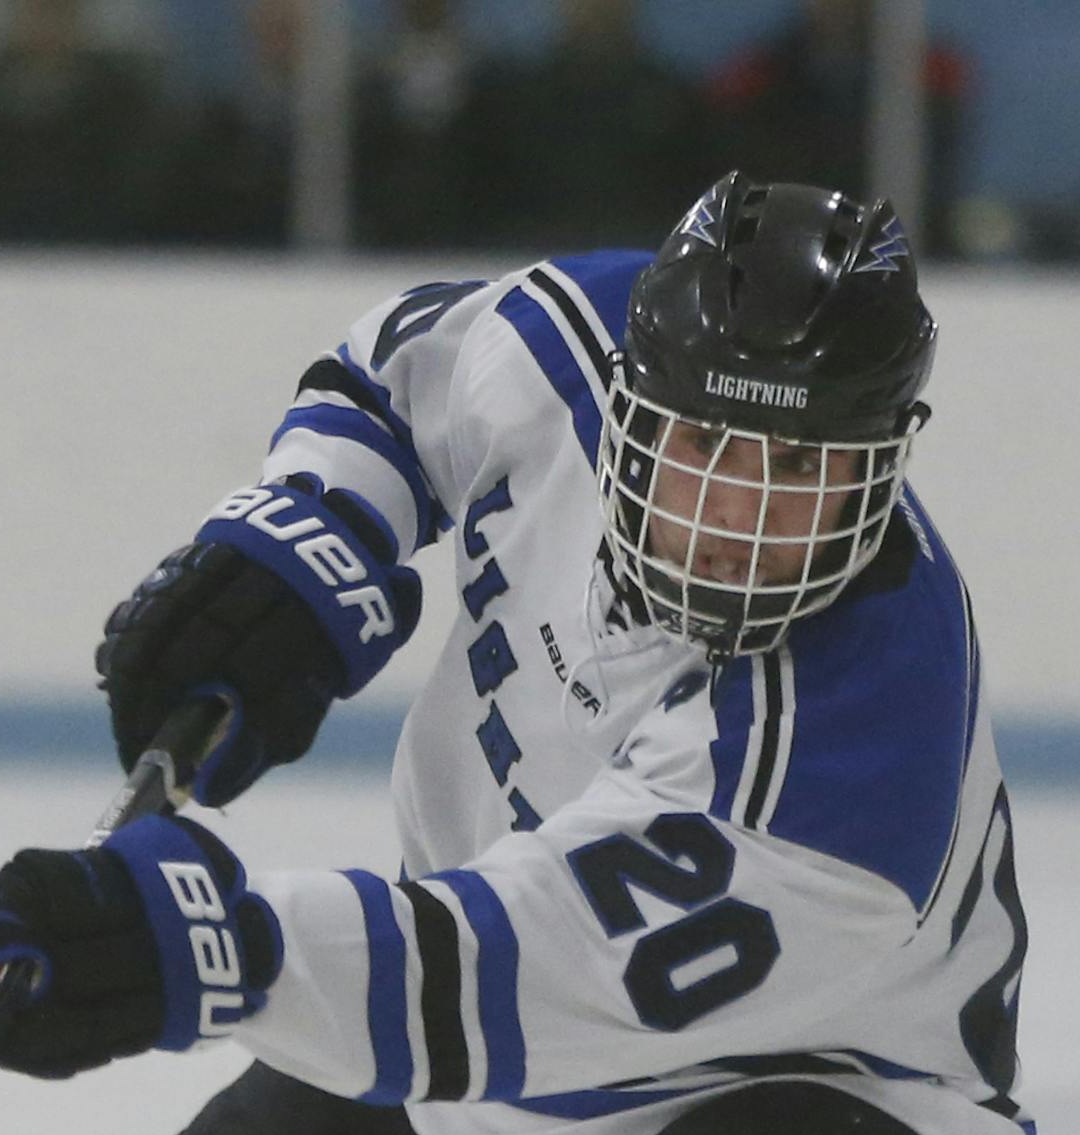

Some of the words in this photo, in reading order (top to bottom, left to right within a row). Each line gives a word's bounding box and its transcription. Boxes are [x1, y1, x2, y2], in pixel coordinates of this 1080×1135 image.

[705, 371, 809, 409] LIGHTNING
[539, 622, 602, 719] BAUER
[565, 812, 782, 1032] 20
